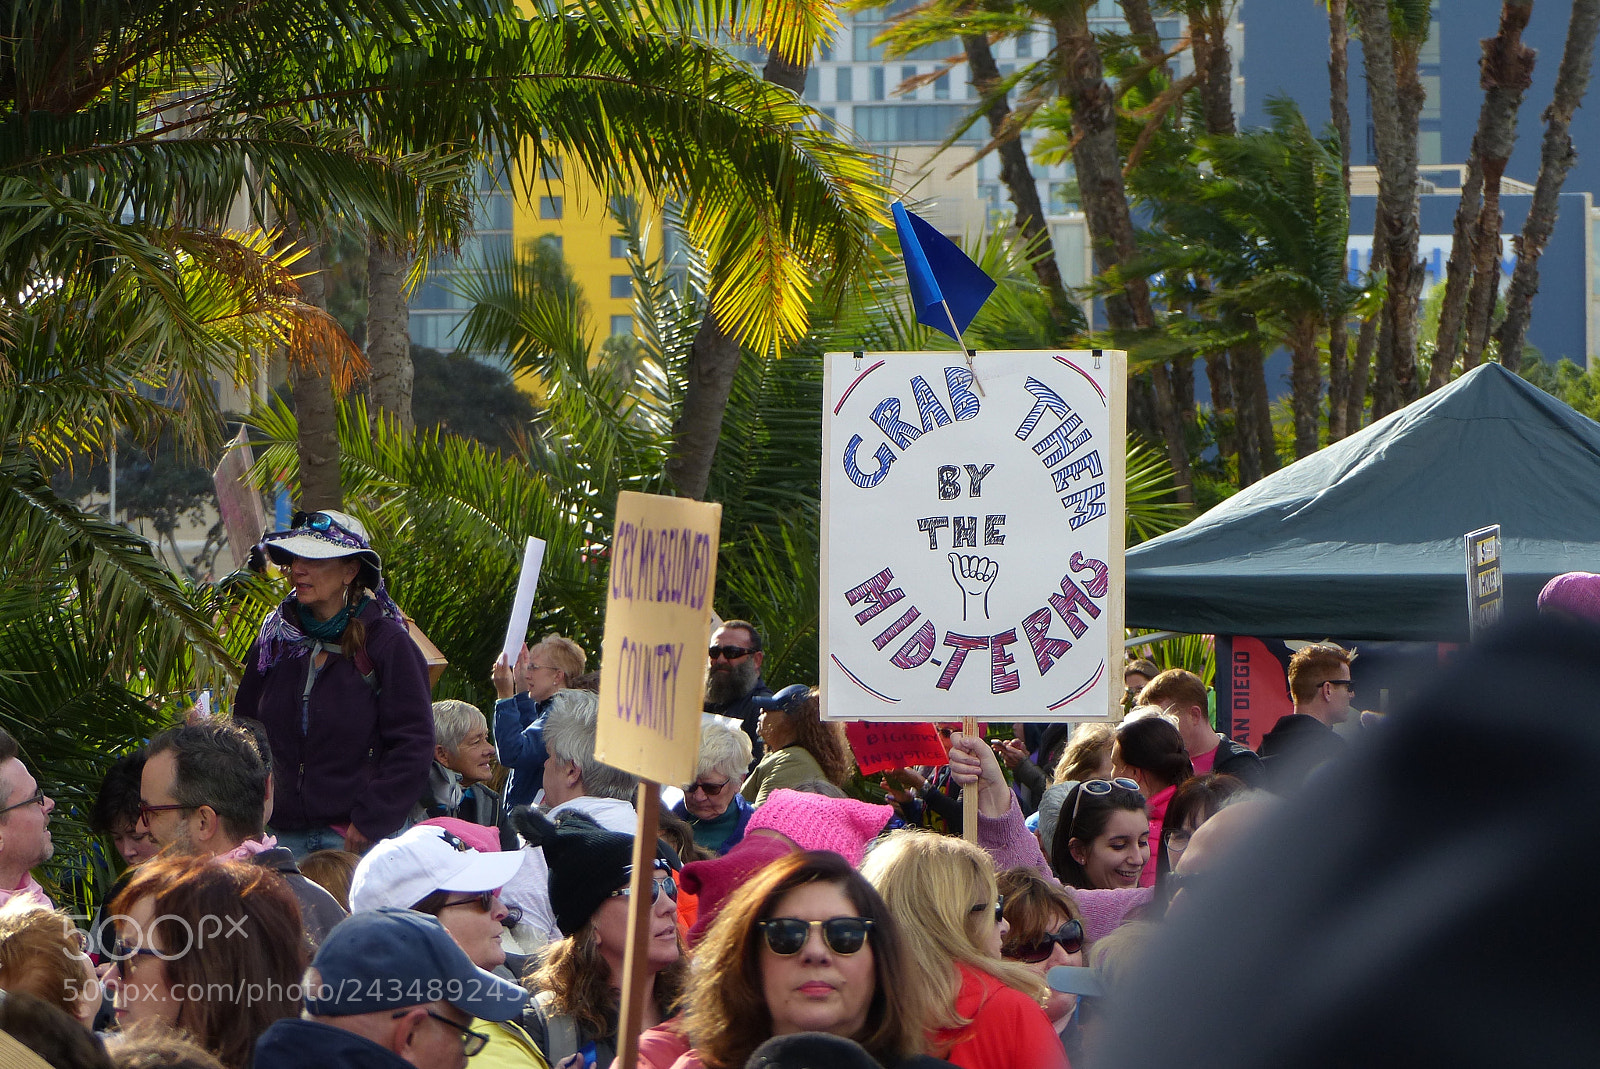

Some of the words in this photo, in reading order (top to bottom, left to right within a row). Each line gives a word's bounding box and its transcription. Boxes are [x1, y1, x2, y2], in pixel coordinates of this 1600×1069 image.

[843, 366, 981, 489] GRAB
[1015, 376, 1107, 532] THEM
[937, 463, 995, 500] BY
[916, 514, 1006, 550] THE
[844, 550, 1109, 695] MID-TERMS
[617, 636, 684, 741] COUNTRY
[1233, 651, 1251, 710] DIEGO
[1234, 718, 1250, 746] AN
[862, 750, 943, 766] INJUSTICE
